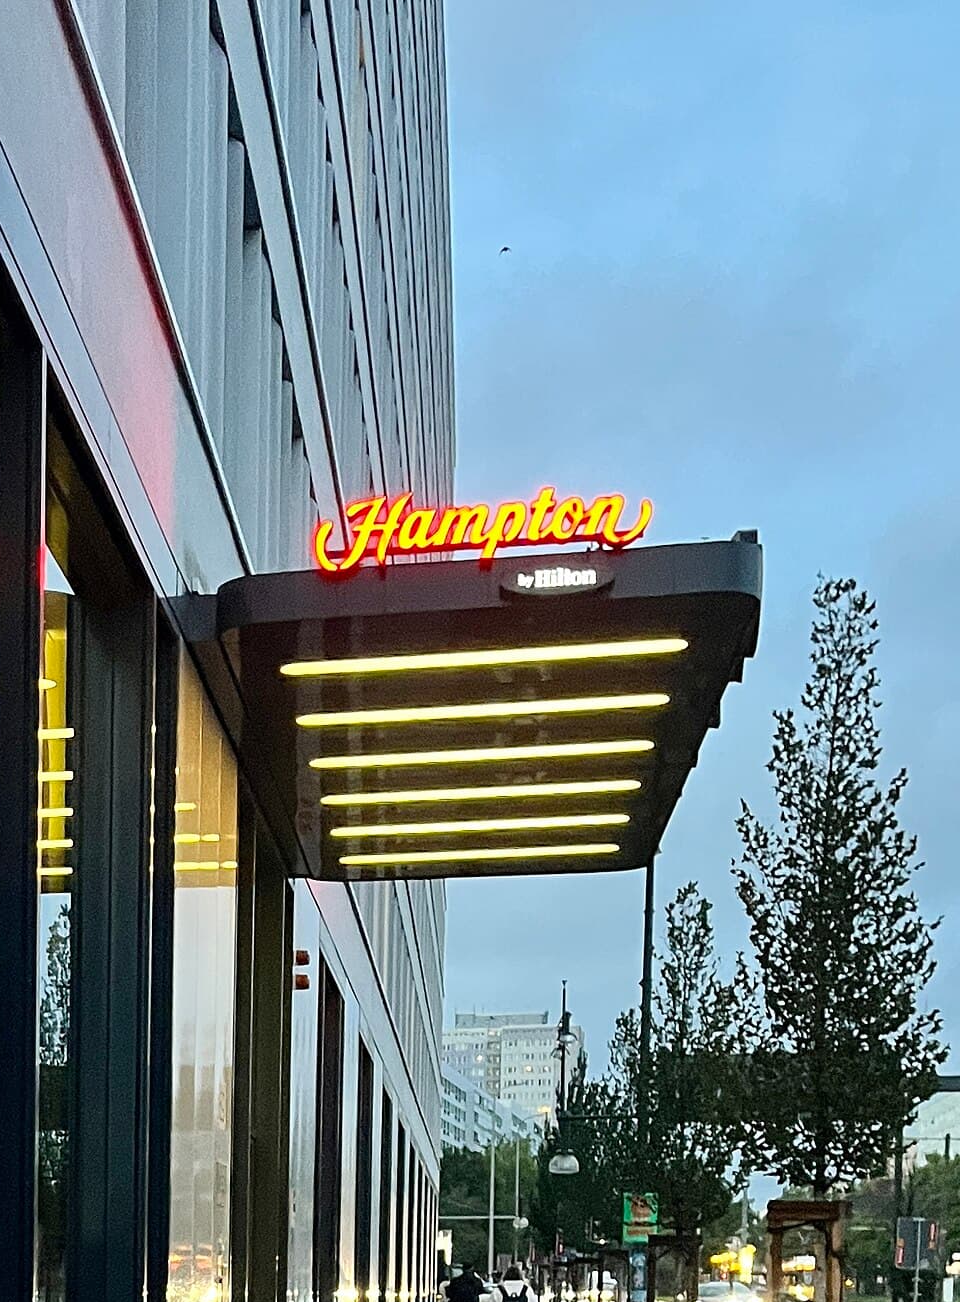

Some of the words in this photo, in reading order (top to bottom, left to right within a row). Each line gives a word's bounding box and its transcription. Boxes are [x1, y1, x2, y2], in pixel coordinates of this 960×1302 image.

[315, 487, 653, 571] Hampton
[517, 573, 534, 589] by
[534, 567, 597, 588] Hilton
